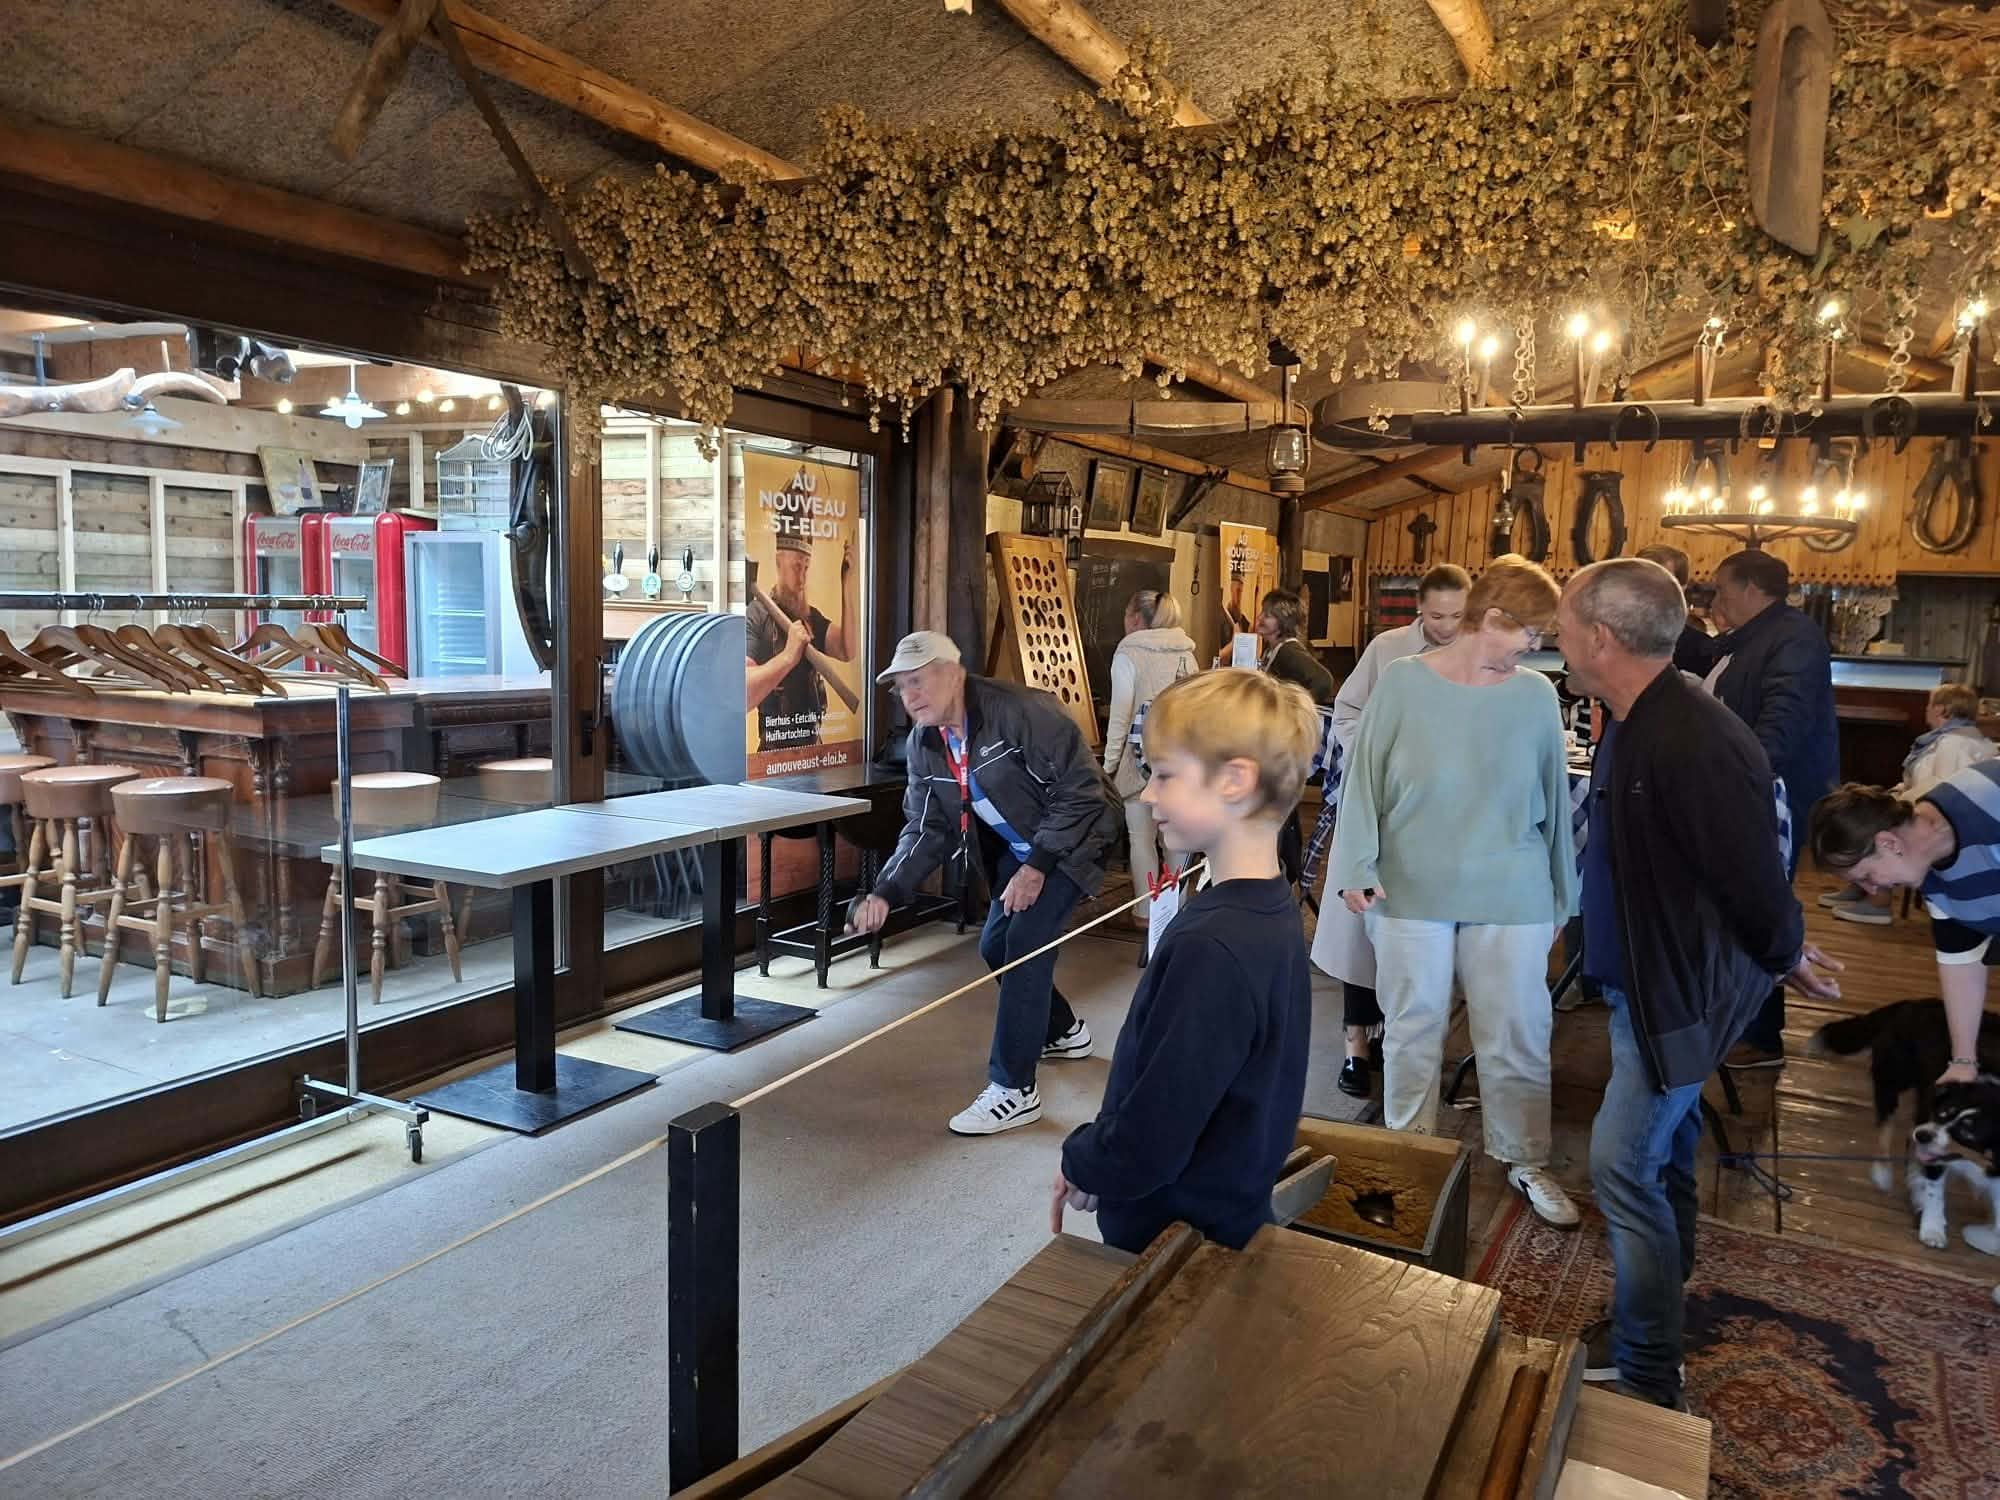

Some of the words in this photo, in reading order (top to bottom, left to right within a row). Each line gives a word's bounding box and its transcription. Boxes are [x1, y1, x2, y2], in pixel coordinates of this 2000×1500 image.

[791, 471, 817, 492] AU
[759, 489, 847, 518] NOUVEAU
[768, 512, 838, 540] ST-ELOI
[765, 713, 791, 728] Bierhuis
[766, 751, 848, 775] aunouveaust-eloi.be
